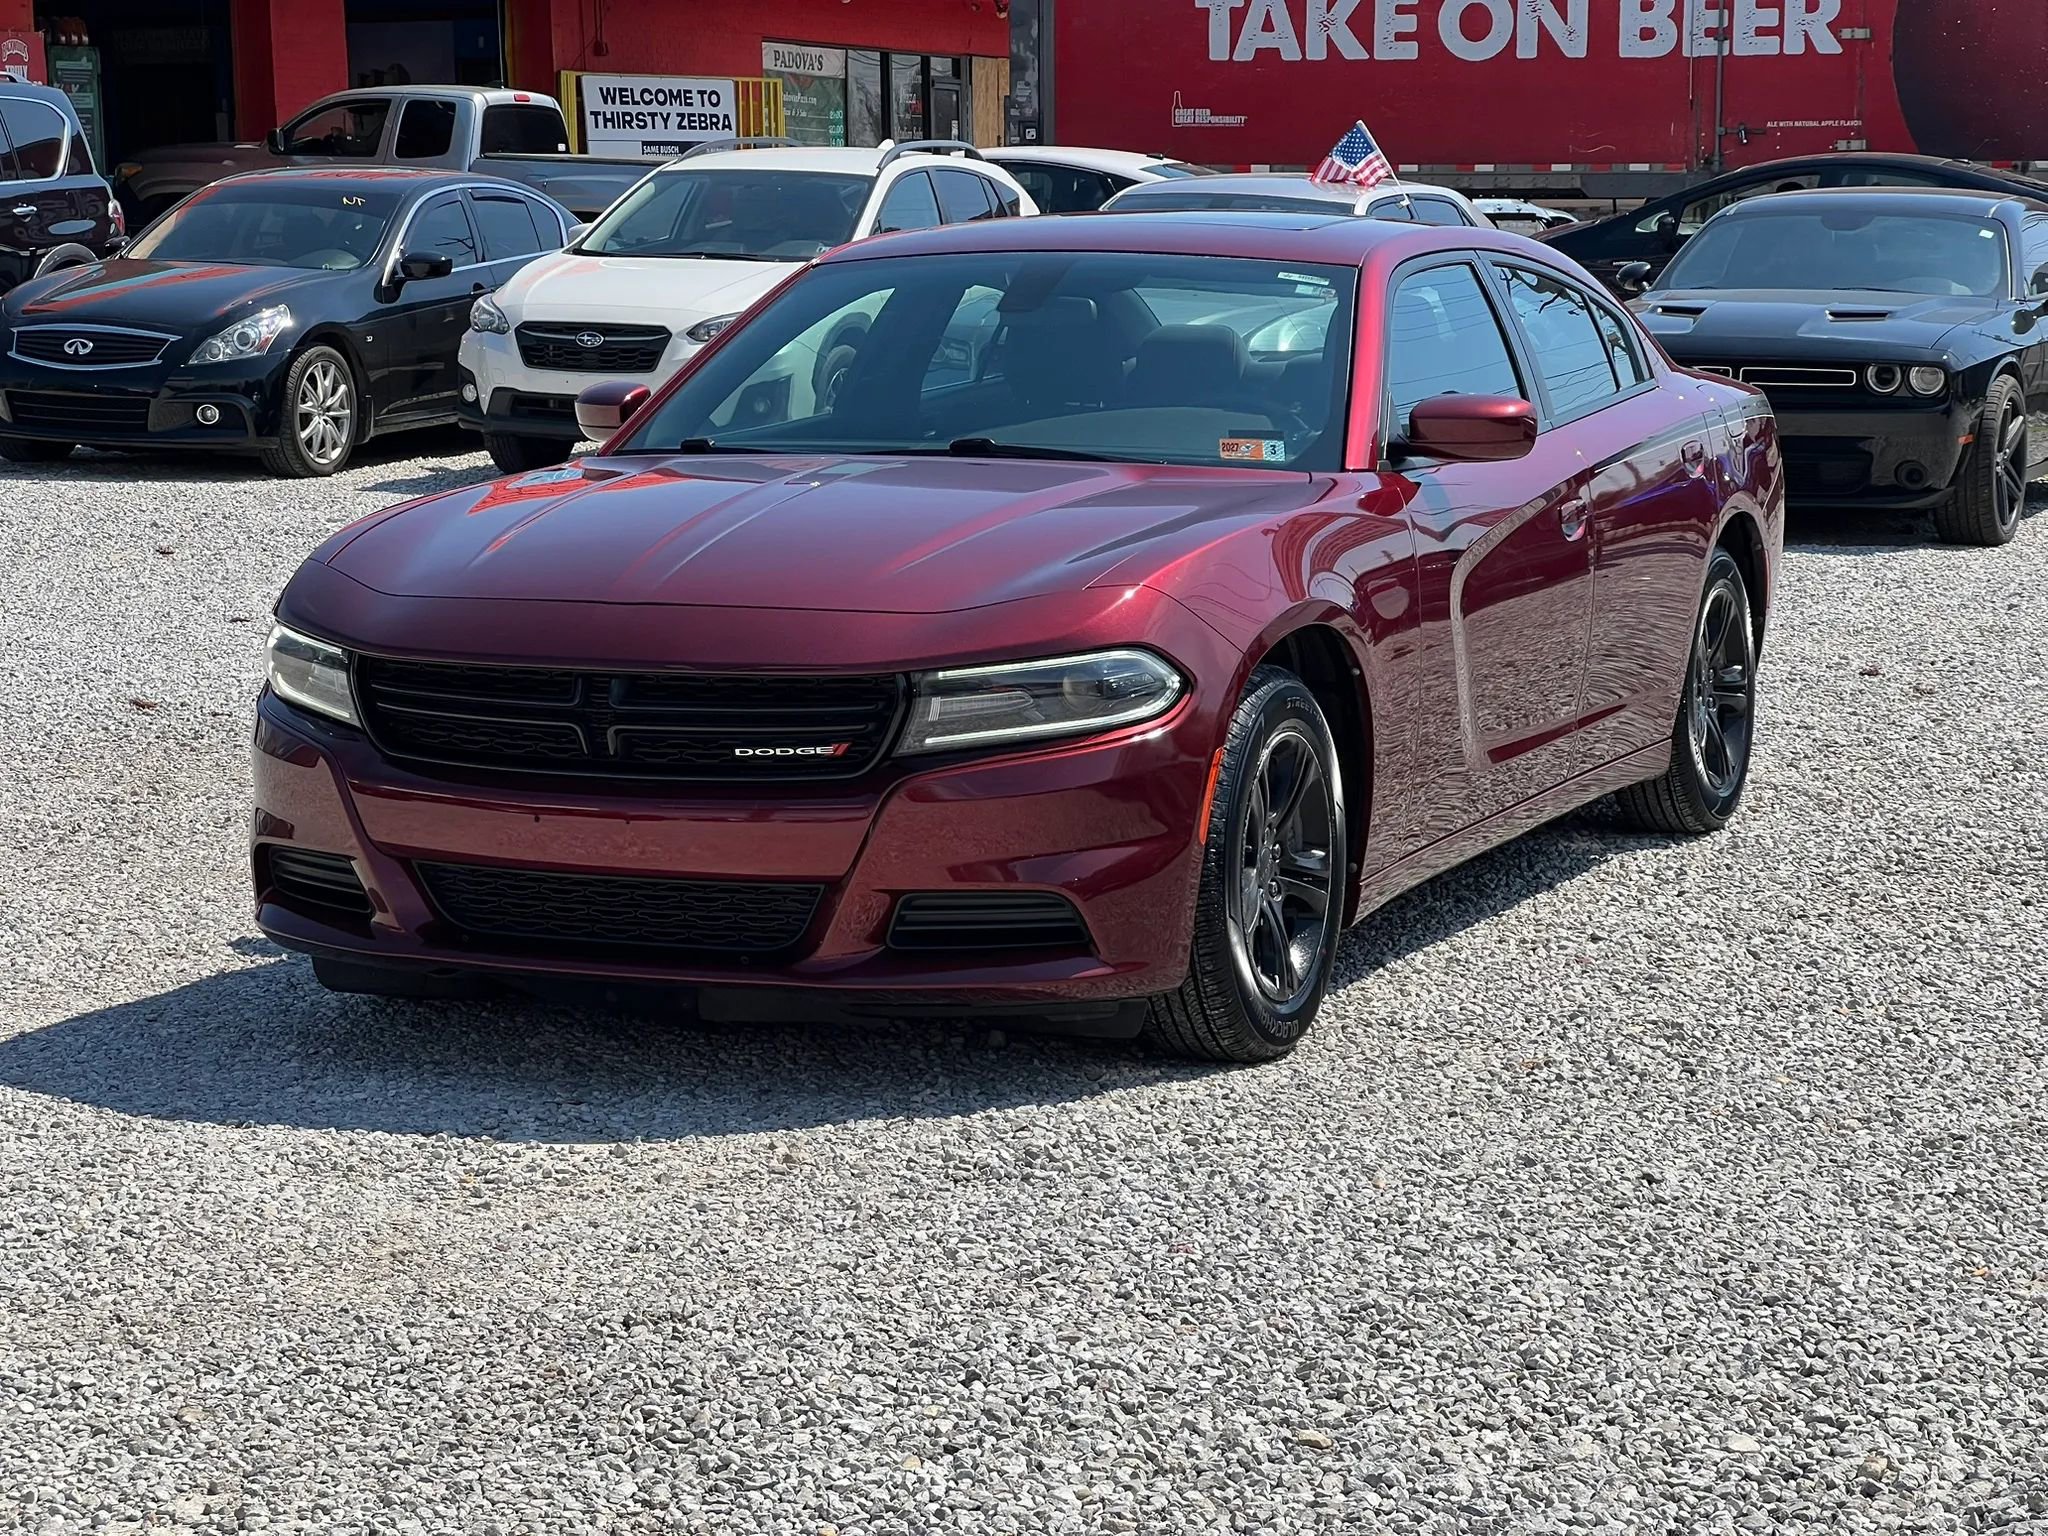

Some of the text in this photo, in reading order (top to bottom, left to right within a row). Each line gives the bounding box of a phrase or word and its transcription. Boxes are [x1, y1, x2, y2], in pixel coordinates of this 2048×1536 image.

[1194, 0, 1844, 61] TAKE ON BEER
[773, 50, 824, 71] PADOVA'S
[599, 86, 721, 108] WELCOME TO
[589, 111, 733, 132] THIRSTY ZEBRA
[643, 145, 680, 154] SAME BUSCH
[1221, 442, 1240, 452] 2027
[1269, 444, 1278, 456] 3
[734, 746, 835, 756] DODGE
